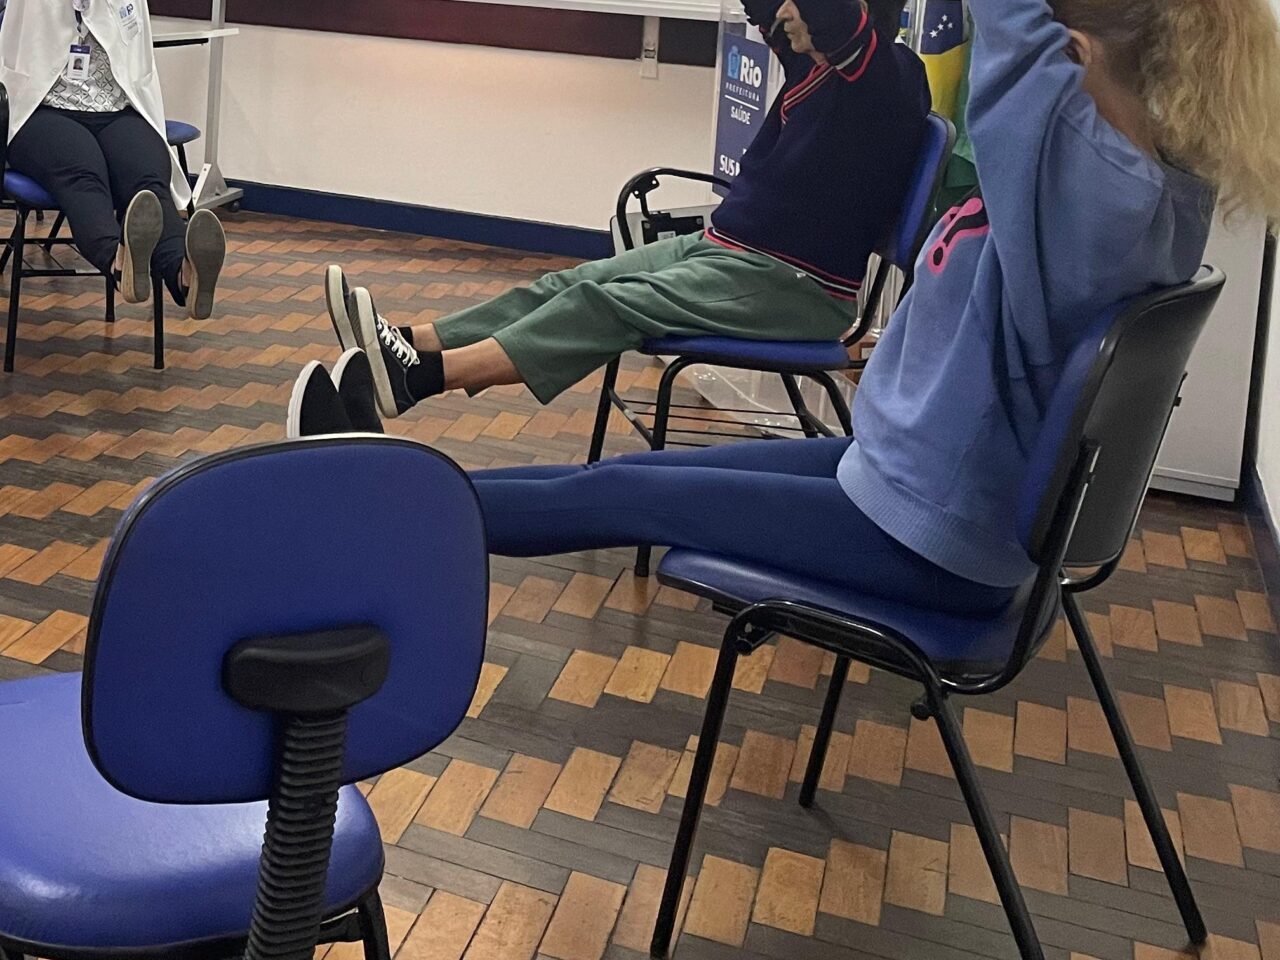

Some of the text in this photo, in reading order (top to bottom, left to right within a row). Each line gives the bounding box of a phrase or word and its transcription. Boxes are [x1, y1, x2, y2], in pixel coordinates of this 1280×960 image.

[739, 55, 762, 88] Rio
[725, 82, 760, 101] PREFEITURA
[730, 105, 751, 125] SAÚDE
[719, 154, 735, 177] SUS
